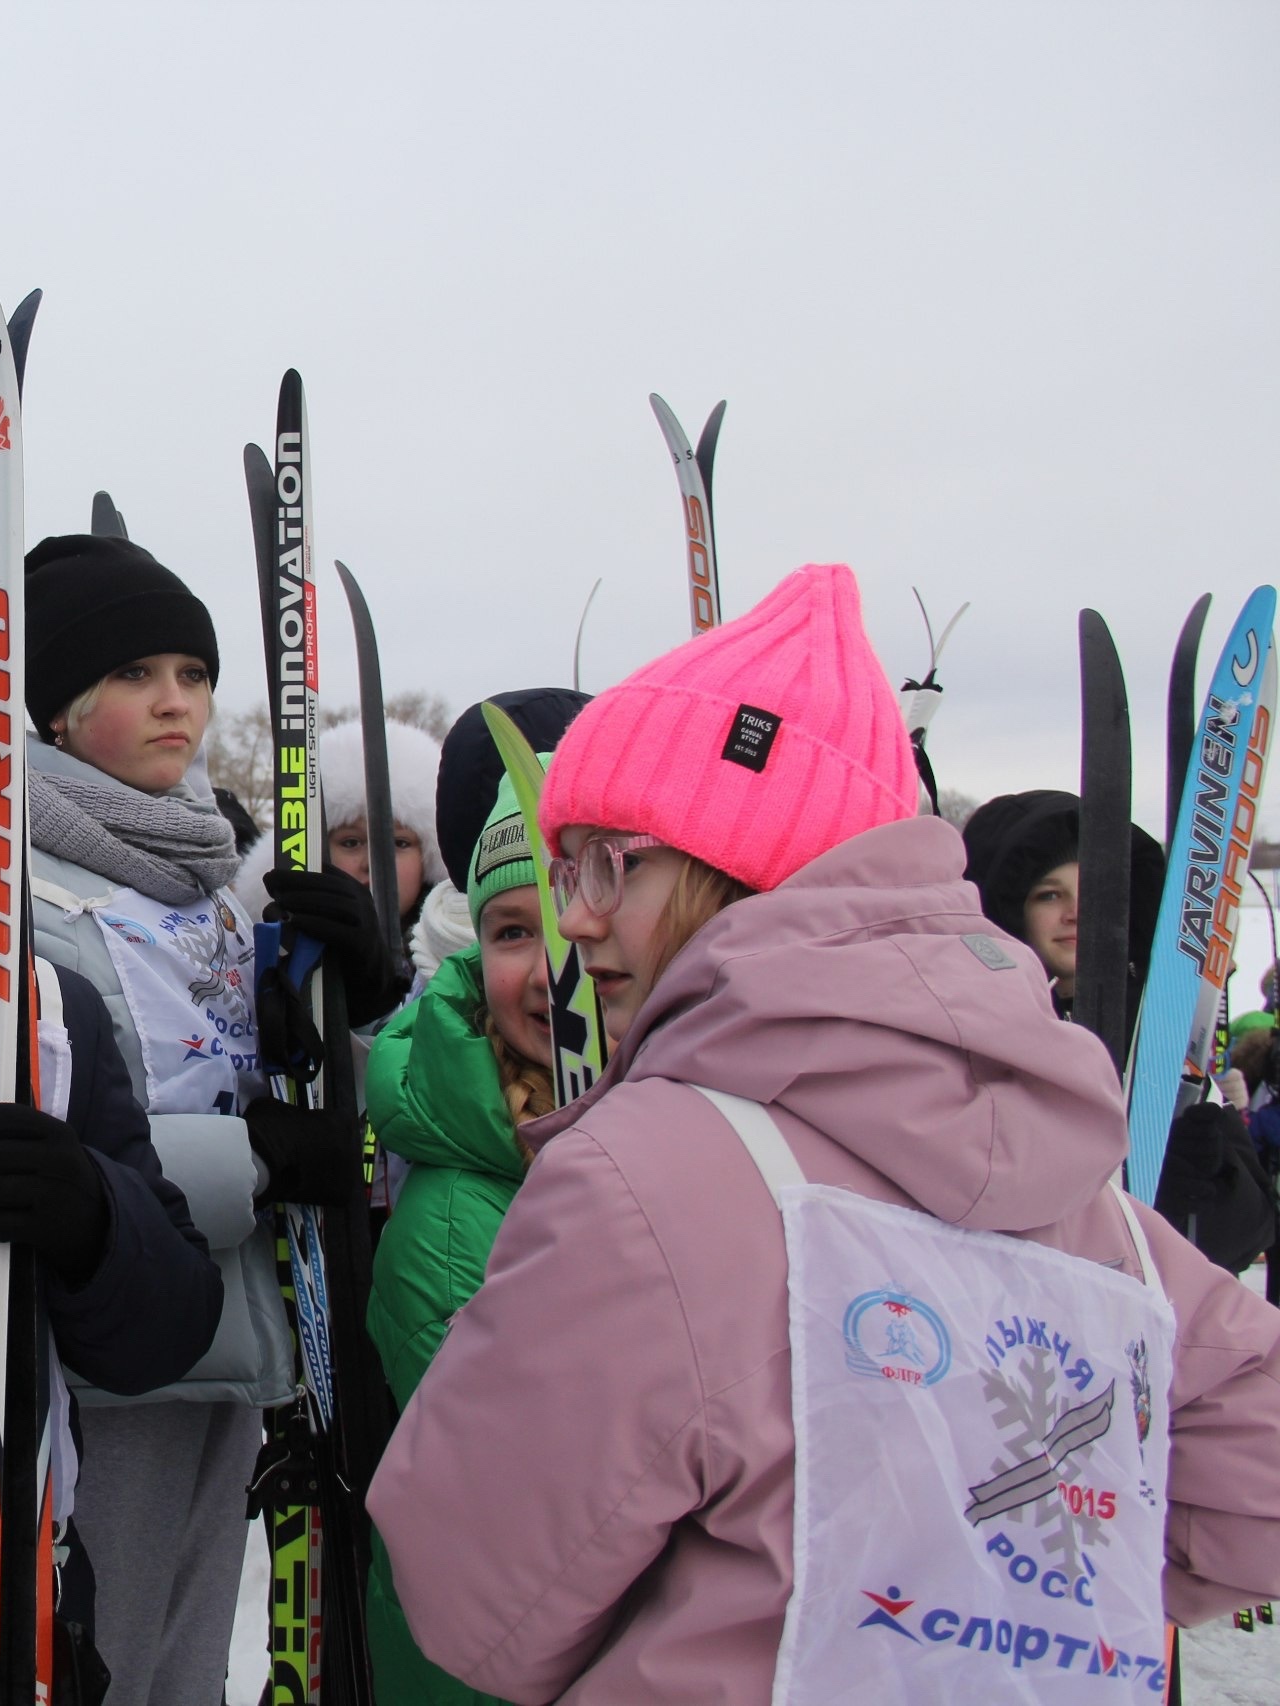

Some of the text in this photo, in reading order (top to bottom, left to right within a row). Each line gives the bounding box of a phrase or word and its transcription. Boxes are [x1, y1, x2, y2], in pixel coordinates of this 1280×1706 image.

[305, 590, 315, 657] PROFILE
[307, 696, 317, 750] SPORT
[741, 713, 773, 732] TRIKS
[280, 746, 307, 872] ABLE
[1177, 694, 1241, 978] JÄRVINEN
